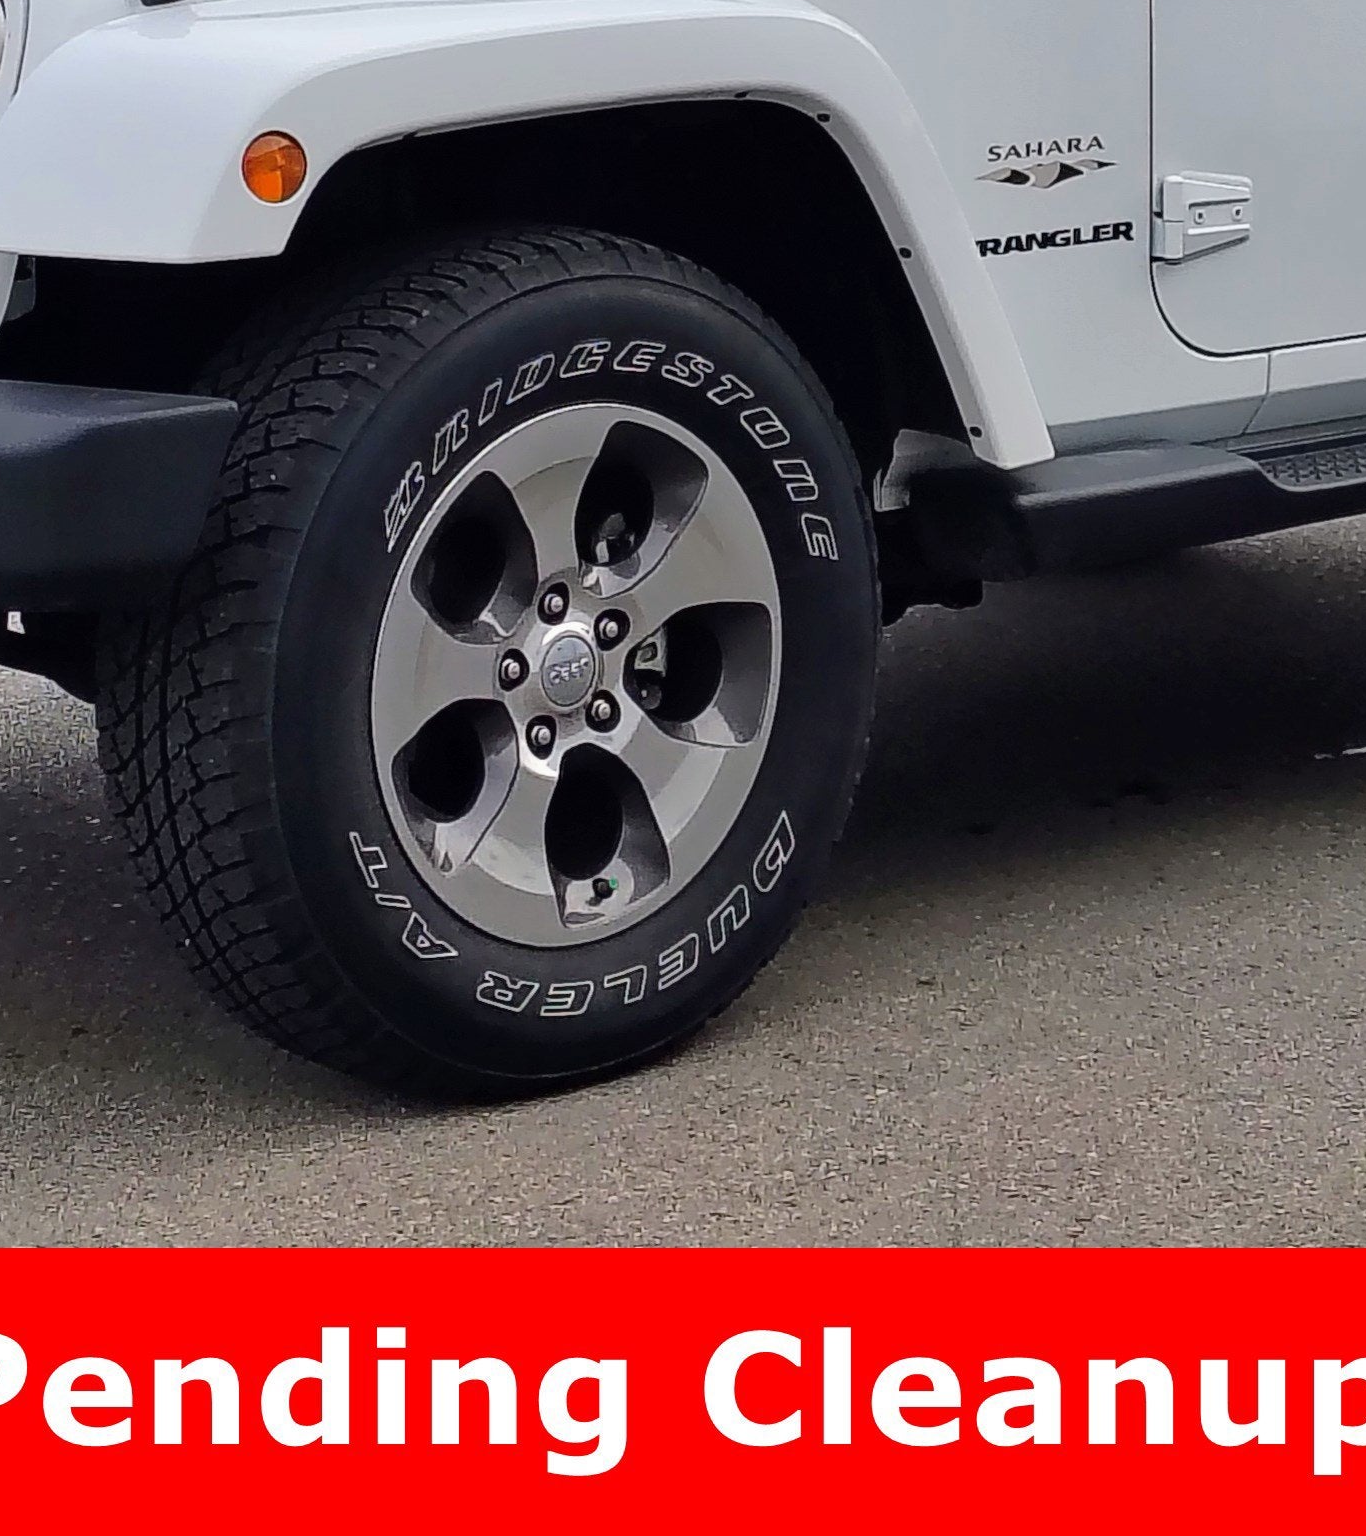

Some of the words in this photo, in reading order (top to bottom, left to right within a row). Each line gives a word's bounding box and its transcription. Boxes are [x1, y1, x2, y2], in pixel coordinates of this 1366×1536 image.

[987, 135, 1105, 162] SAHARA
[975, 221, 1134, 257] RANGLER
[384, 340, 839, 561] BRIDGESTONE
[349, 830, 459, 959] A/T
[476, 809, 796, 1017] DUELER
